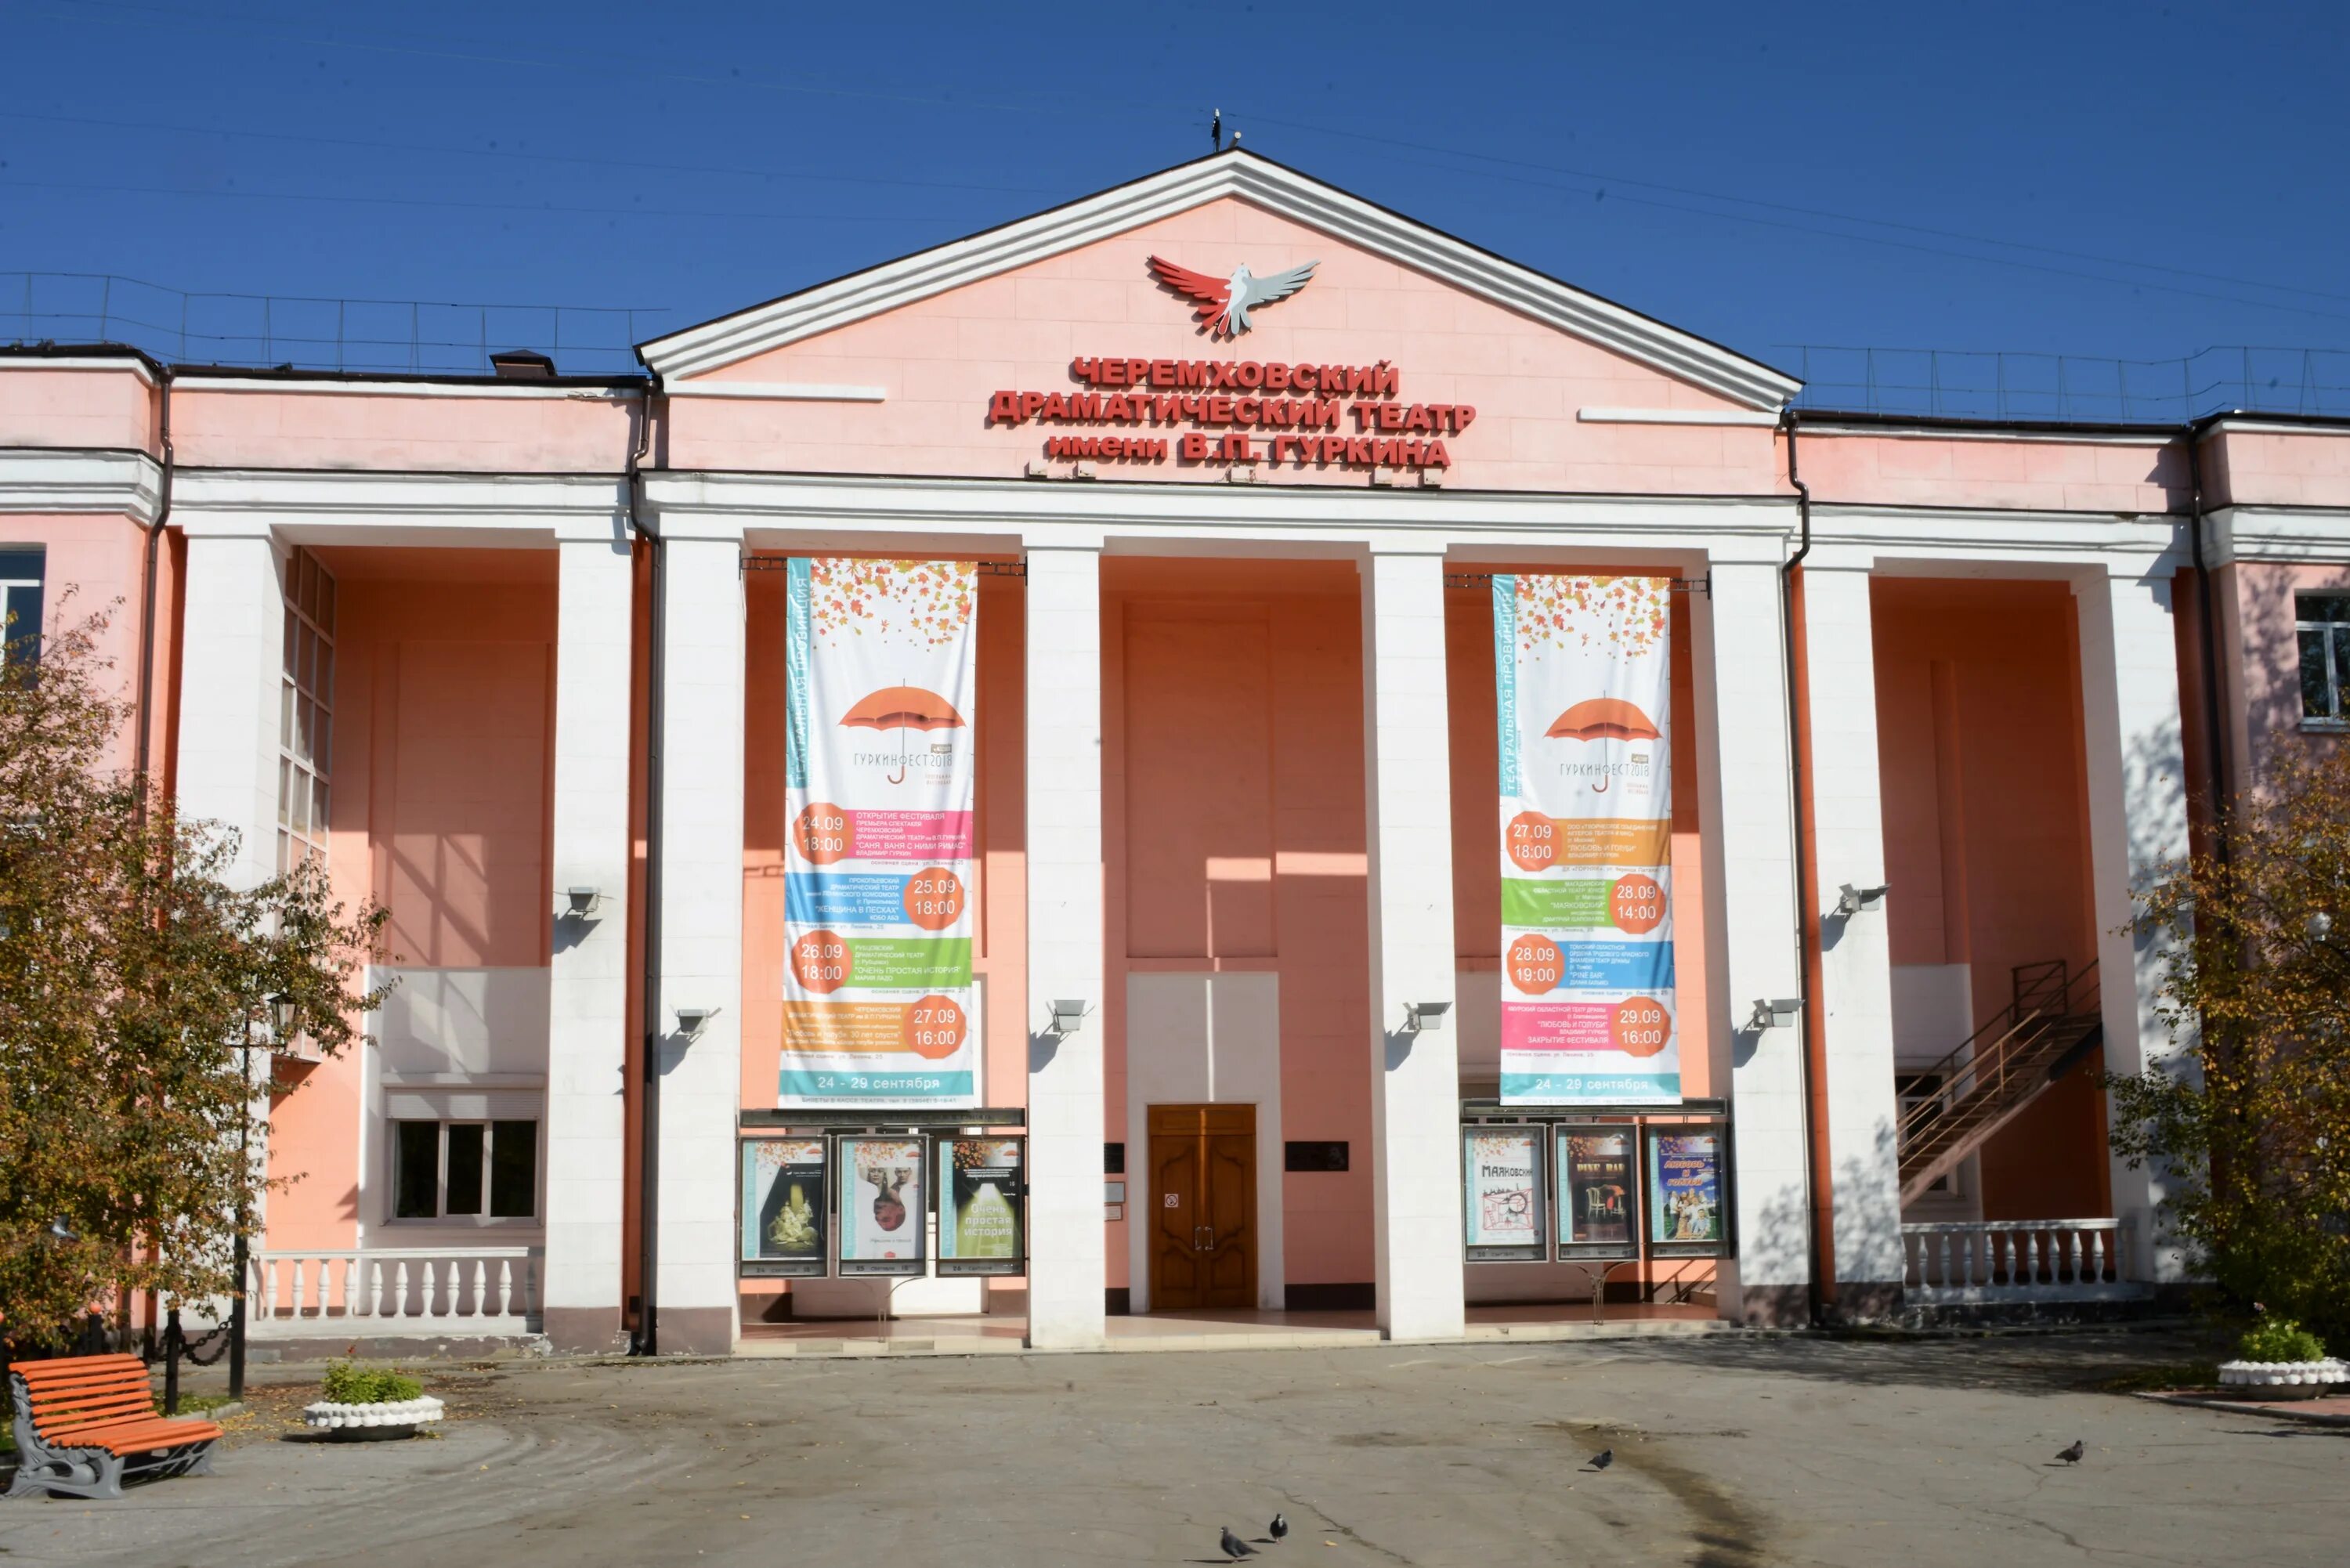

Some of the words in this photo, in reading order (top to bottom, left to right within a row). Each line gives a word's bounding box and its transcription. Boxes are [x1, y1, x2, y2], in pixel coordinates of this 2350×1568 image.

[1074, 356, 1398, 393] ЧЕРЕМХОВСКИЙ
[990, 390, 1340, 426] ДРАМАТИЧЕСКИЙ
[1354, 400, 1476, 431] ТЕАТР
[1048, 435, 1167, 459] имени
[1184, 432, 1262, 460] В.П.
[1274, 435, 1450, 466] ГУРКИНА
[796, 577, 808, 671] ПРОВИНЦИЯ
[1502, 592, 1515, 685] ПРОВИНЦИЯ
[795, 677, 808, 782] ТЕАТРАЛЬНАЯ
[1503, 689, 1517, 792] ТЕАТРАЛЬНАЯ
[803, 816, 844, 831] 24.09
[900, 812, 945, 821] ФЕСТИВАЛЯ
[1513, 825, 1552, 838] 27.09
[804, 837, 844, 852] 18:00
[1514, 845, 1552, 858] 18:00
[914, 880, 956, 894] 25.09
[1617, 886, 1655, 899] 28.09
[915, 901, 956, 915] 18:00
[1618, 906, 1656, 919] 14:00
[801, 944, 842, 958] 26.09
[1515, 947, 1555, 961] 28.09
[801, 966, 842, 980] 18:00
[1516, 968, 1555, 981] 19:00
[914, 1010, 956, 1024] 27.09
[1620, 1010, 1660, 1023] 29.09
[915, 1031, 956, 1045] 16:00
[1622, 1031, 1661, 1044] 16:00
[818, 1077, 834, 1089] 24
[851, 1077, 868, 1089] 29
[873, 1076, 940, 1091] сентября
[1535, 1078, 1551, 1089] 24
[1566, 1078, 1582, 1089] 29
[1587, 1078, 1648, 1093] сентября
[1664, 1160, 1705, 1169] ЛЮБОВЬ
[971, 1203, 1006, 1214] Очень
[966, 1216, 1012, 1227] простая
[964, 1227, 1013, 1237] история
